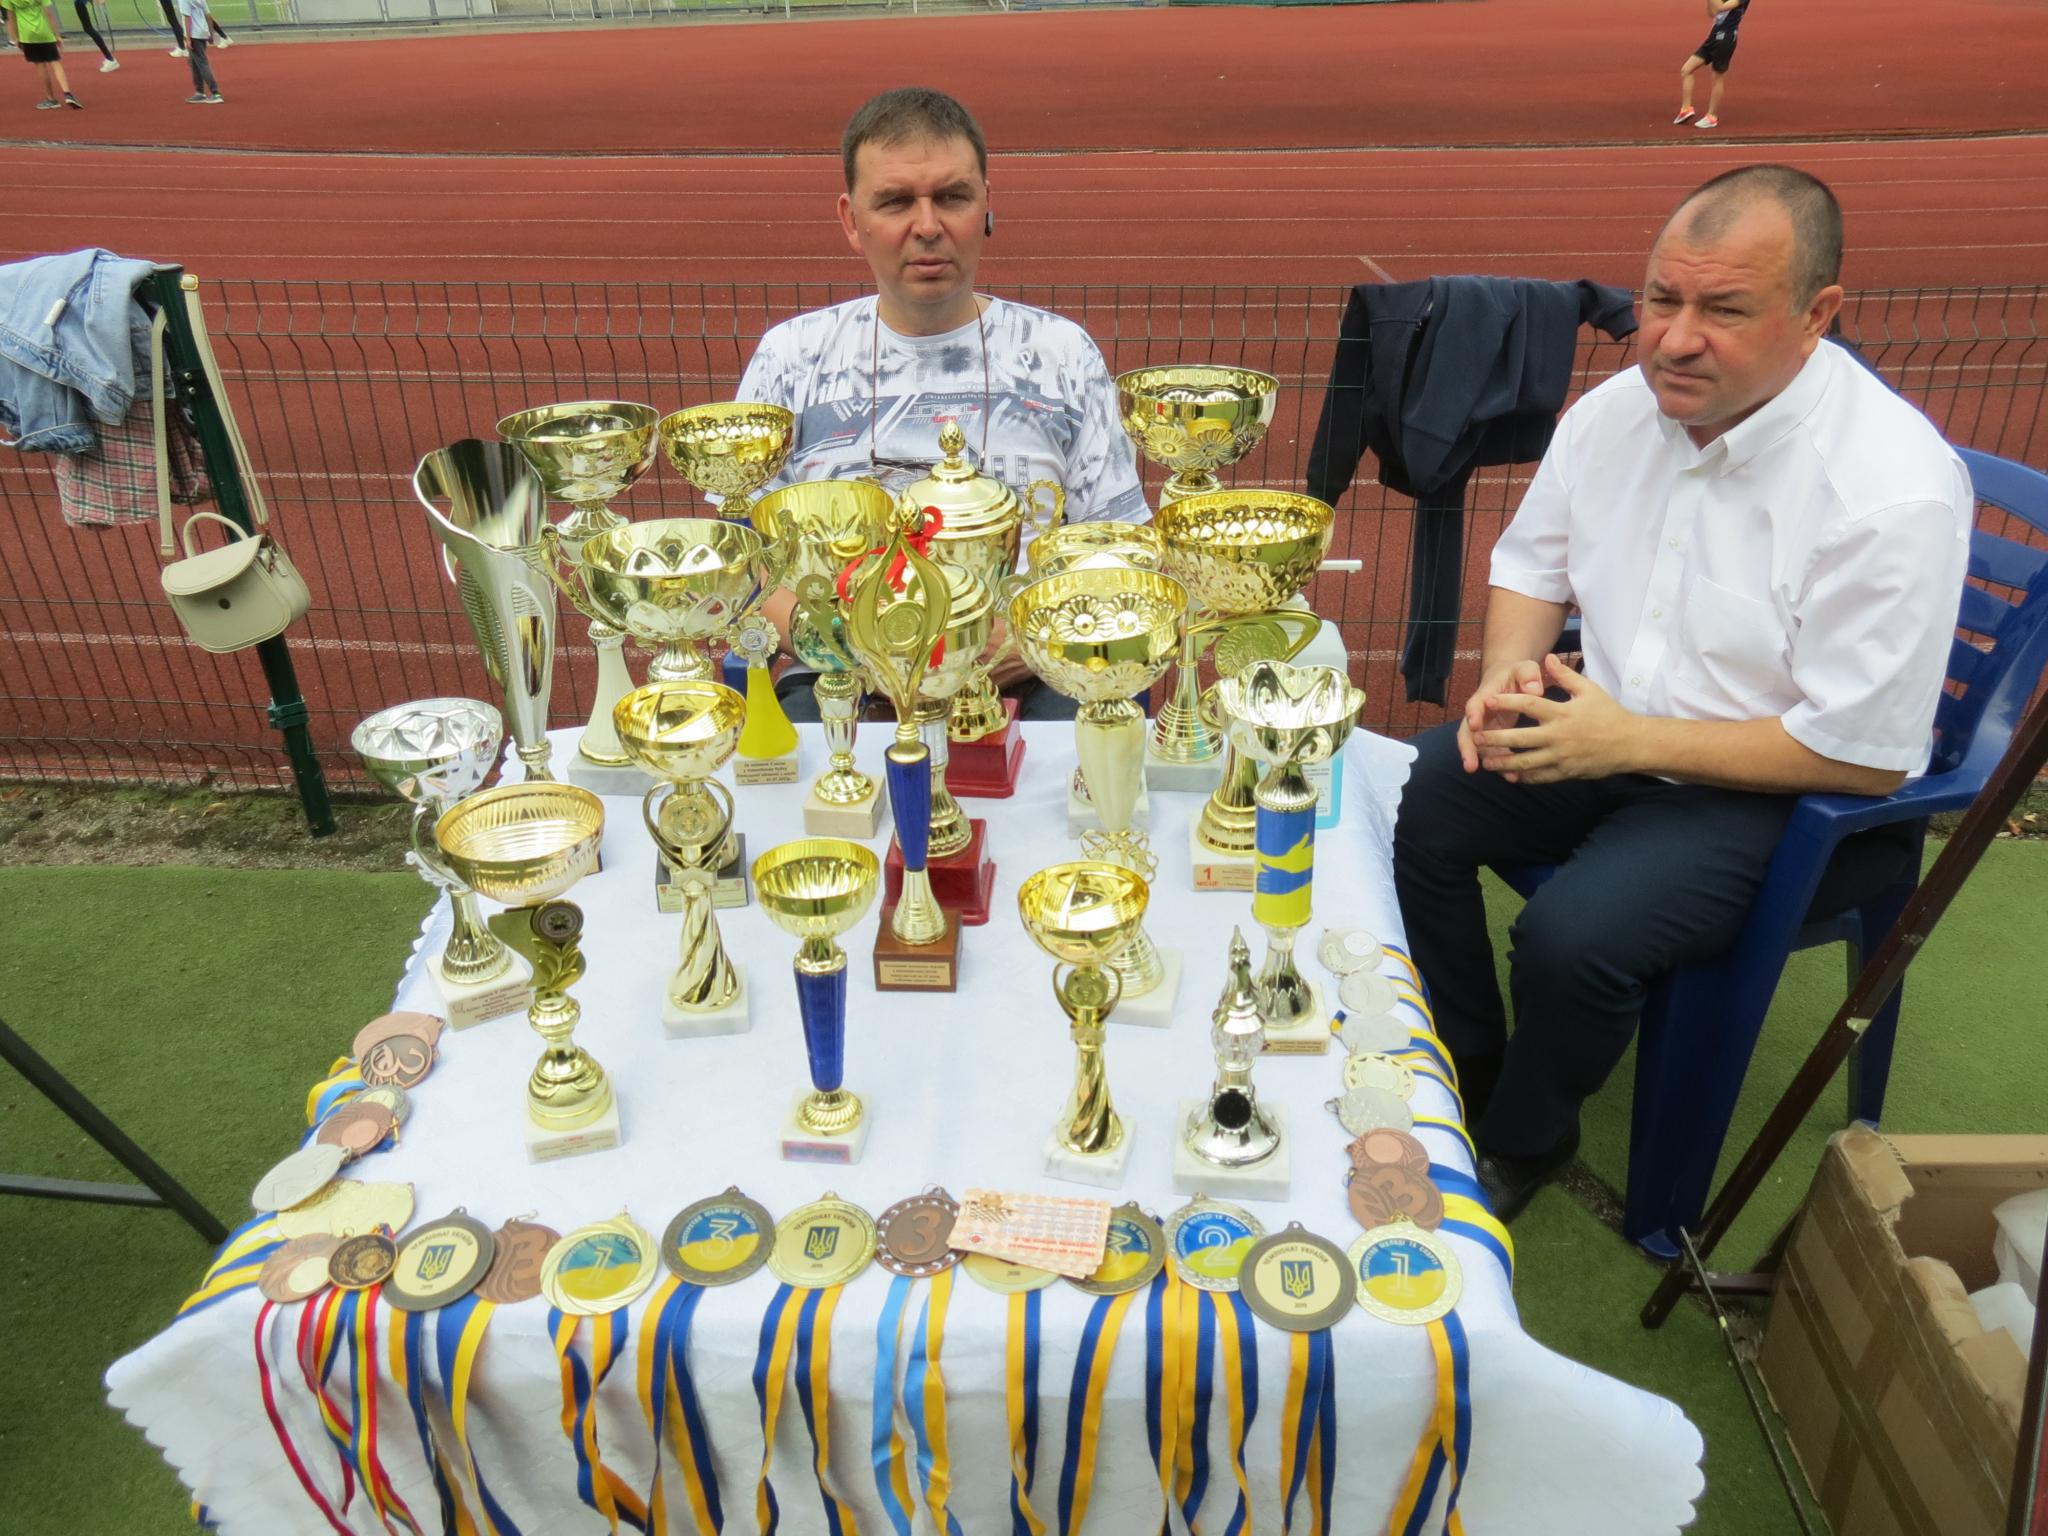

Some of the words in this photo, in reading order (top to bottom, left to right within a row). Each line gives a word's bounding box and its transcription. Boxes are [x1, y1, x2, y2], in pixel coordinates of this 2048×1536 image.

[1203, 866, 1211, 881] 1
[700, 1218, 739, 1261] 3
[902, 1208, 942, 1256] 3
[1198, 1225, 1237, 1267] 2
